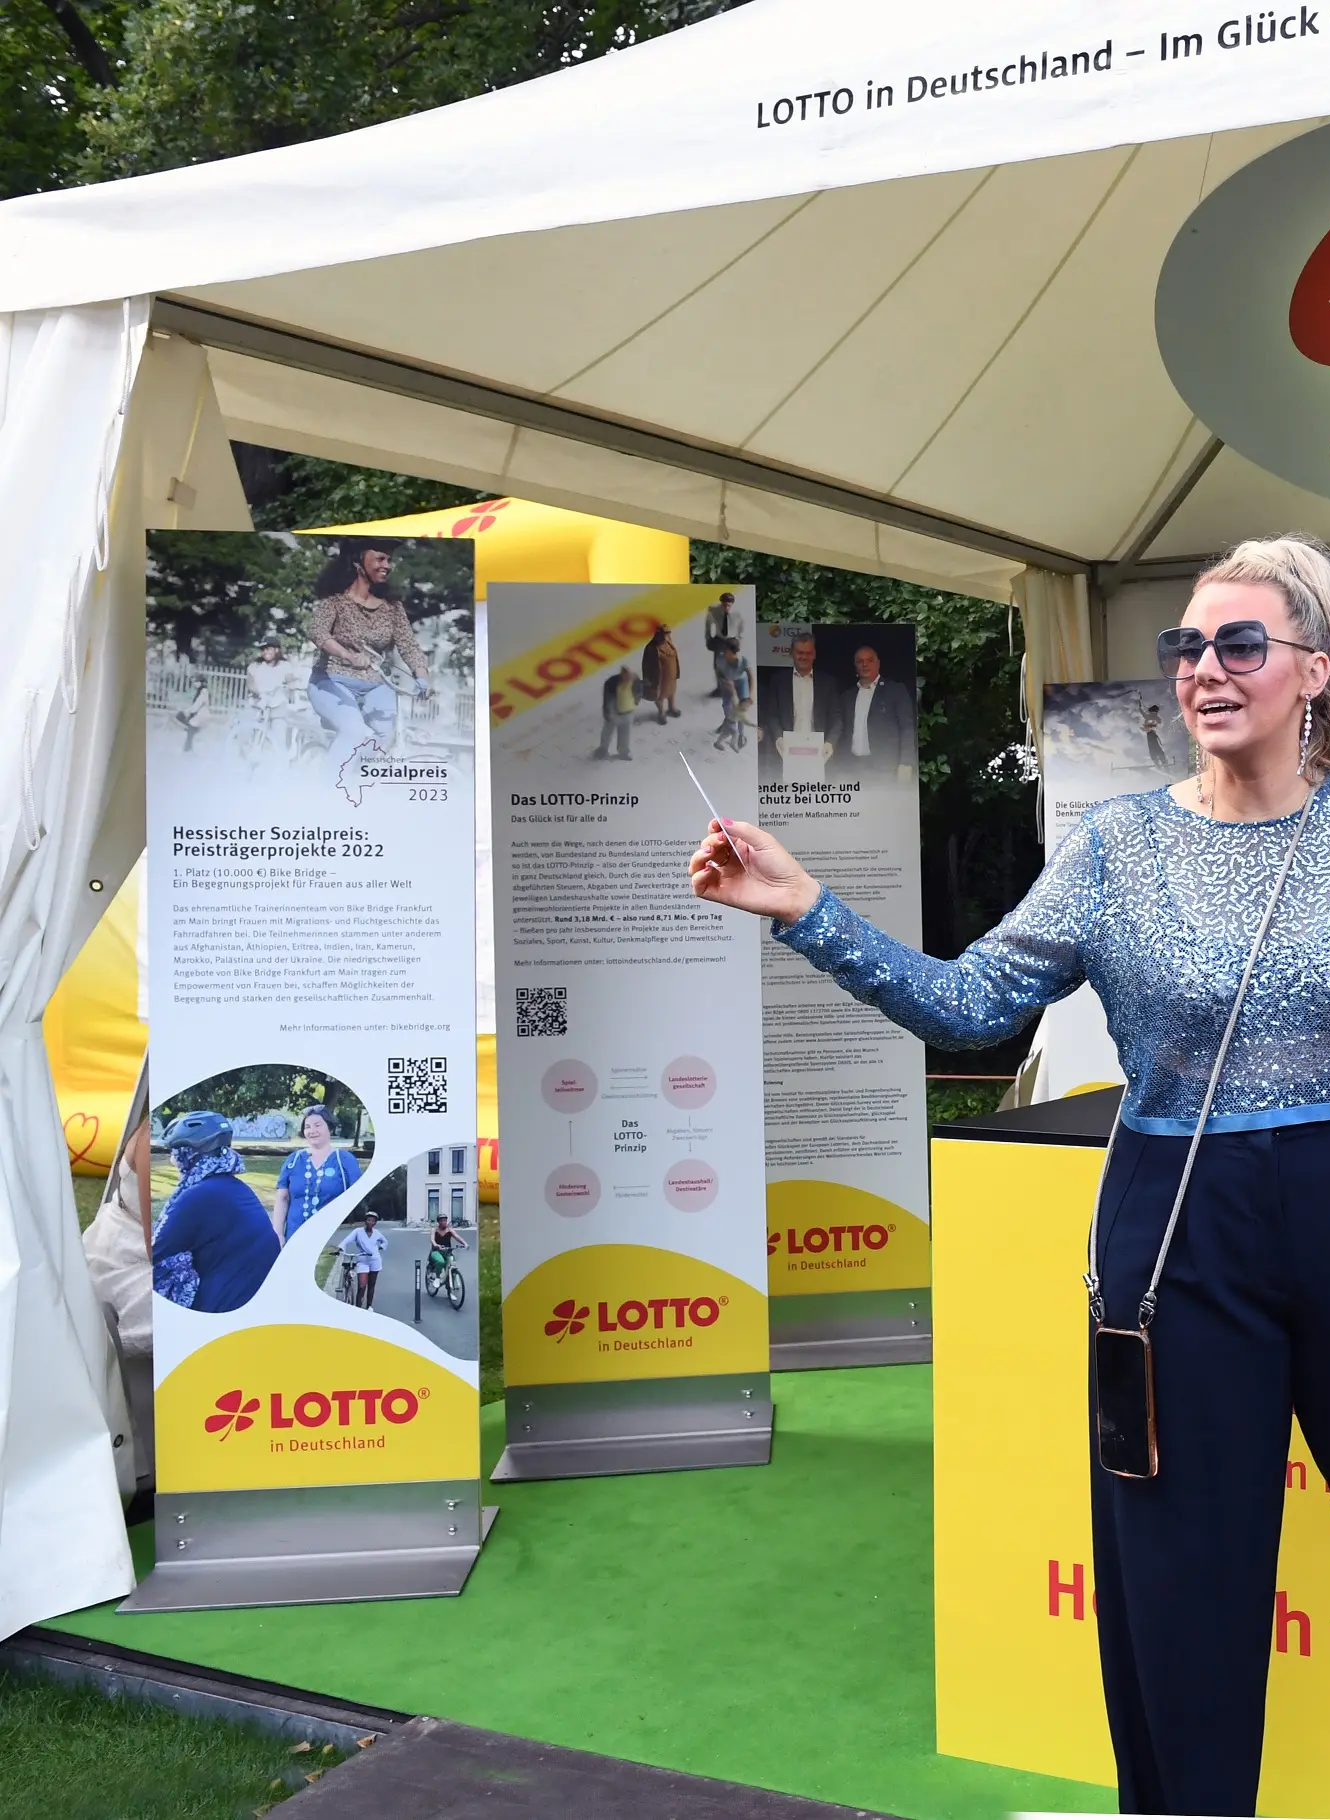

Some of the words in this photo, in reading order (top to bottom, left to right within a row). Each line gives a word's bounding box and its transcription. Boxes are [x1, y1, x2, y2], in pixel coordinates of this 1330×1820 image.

[756, 86, 855, 129] LOTTO
[866, 80, 893, 112] in
[906, 40, 1113, 104] Deutschland
[1159, 31, 1203, 62] Im
[1217, 6, 1319, 51] Glück
[507, 612, 661, 700] LOTTO
[360, 755, 406, 764] Hessischer
[360, 765, 448, 780] Sozialpreis
[758, 783, 789, 794] ender
[792, 781, 836, 795] Spieler-
[839, 781, 860, 792] und
[408, 788, 448, 802] 2023
[510, 793, 537, 806] Das
[540, 792, 639, 809] LOTTO-Prinzip
[759, 793, 791, 805] chutz
[794, 793, 812, 804] bei
[814, 793, 852, 804] LOTTO
[1055, 801, 1067, 809] Die
[510, 814, 527, 824] Das
[528, 814, 553, 824] Glück
[553, 814, 565, 823] ist
[566, 814, 578, 823] für
[579, 814, 596, 823] alle
[597, 813, 608, 823] da
[782, 811, 804, 819] vielen
[804, 810, 848, 819] Maßnahmen
[174, 826, 266, 840] Hessischer
[271, 826, 368, 842] Sozialpreis:
[174, 843, 336, 860] Preisträgerprojekte
[343, 844, 383, 857] 2022
[173, 868, 183, 878] 1.
[185, 867, 211, 878] Platz
[213, 867, 254, 879] (10.000
[256, 867, 267, 879] €)
[269, 867, 292, 878] Bike
[294, 867, 327, 880] Bridge
[172, 878, 189, 889] Ein
[191, 878, 290, 891] Begegnungsprojekt
[292, 878, 306, 889] für
[309, 879, 343, 889] Frauen
[345, 881, 364, 889] aus
[365, 879, 388, 889] aller
[389, 879, 412, 889] Welt
[172, 904, 189, 913] Das
[191, 903, 252, 913] ehrenamtliche
[254, 904, 328, 913] Trainerinnenteam
[328, 905, 345, 913] von
[346, 904, 365, 913] Bike
[366, 904, 394, 914] Bridge
[395, 904, 433, 913] Frankfurt
[172, 918, 187, 926] am
[188, 917, 210, 926] Main
[211, 915, 237, 927] bringt
[238, 916, 268, 926] Frauen
[269, 916, 284, 925] mit
[285, 917, 333, 927] Migrations-
[334, 916, 351, 925] und
[352, 915, 423, 927] Fluchtgeschichte
[424, 916, 440, 925] das
[554, 915, 573, 923] Rund
[574, 915, 591, 923] 3,18
[591, 915, 609, 923] Mrd.
[609, 914, 615, 922] €
[622, 914, 638, 922] also
[638, 914, 655, 922] rund
[655, 914, 672, 922] 8,71
[673, 913, 689, 921] Mio.
[690, 913, 696, 921] €
[696, 914, 709, 922] pro
[710, 913, 723, 922] Tag
[173, 929, 233, 939] Fahrradfahren
[234, 929, 250, 941] bei.
[252, 929, 267, 939] Die
[268, 929, 339, 939] Teilnehmerinnen
[340, 930, 380, 938] stammen
[381, 930, 403, 938] unter
[405, 929, 442, 938] anderem
[173, 944, 189, 952] aus
[190, 942, 244, 953] Afghanistan,
[245, 941, 290, 953] Äthiopien,
[291, 942, 322, 952] Eritrea,
[323, 942, 354, 953] Indien,
[355, 943, 374, 952] Iran,
[376, 942, 416, 951] Kamerun,
[513, 959, 533, 968] Mehr
[533, 958, 583, 967] Informationen
[605, 955, 727, 965] lottoindeutschland.de/gemeinwohl
[279, 1023, 301, 1032] Mehr
[303, 1023, 362, 1032] Informationen
[363, 1023, 389, 1032] unter:
[390, 1022, 451, 1033] bikebridge.org
[621, 1119, 639, 1129] Das
[613, 1131, 647, 1141] LOTTO-
[614, 1143, 647, 1154] Prinzip
[788, 1261, 798, 1271] in
[800, 1258, 866, 1270] Deutschland
[598, 1339, 610, 1352] in
[614, 1336, 693, 1351] Deutschland
[270, 1440, 284, 1453] in
[289, 1435, 385, 1452] Deutschland
[1286, 1460, 1307, 1491] n
